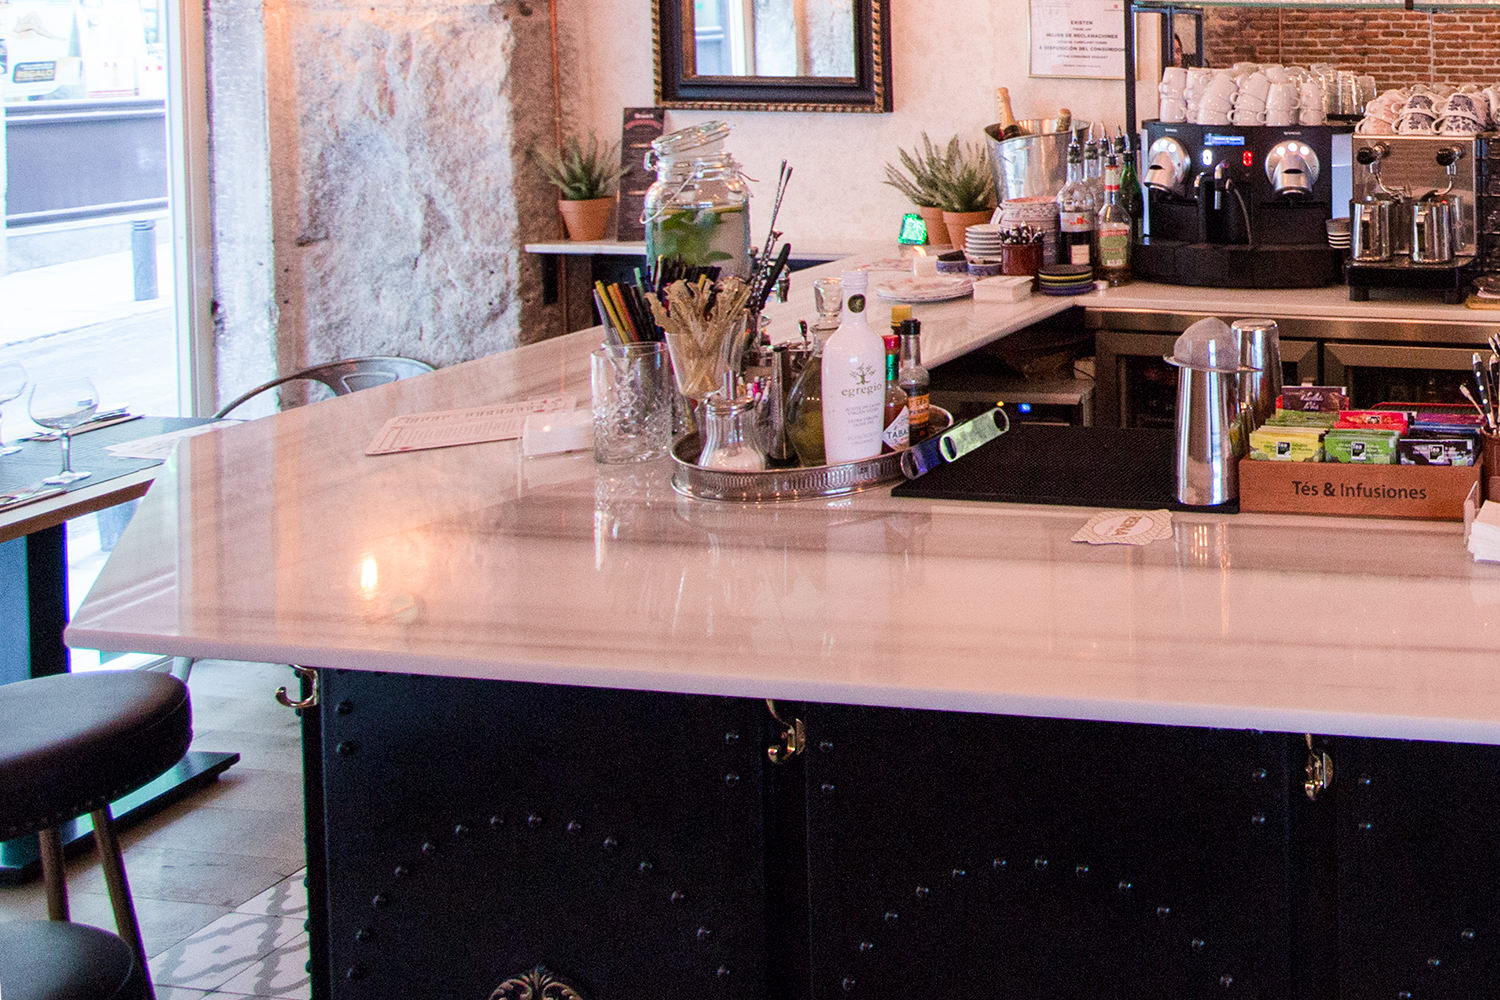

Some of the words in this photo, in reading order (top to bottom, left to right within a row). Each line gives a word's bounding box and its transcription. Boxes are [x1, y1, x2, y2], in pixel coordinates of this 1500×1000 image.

[841, 383, 882, 398] egregio
[1292, 481, 1318, 496] Tés
[1323, 482, 1335, 497] &
[1340, 482, 1427, 500] Infusiones
